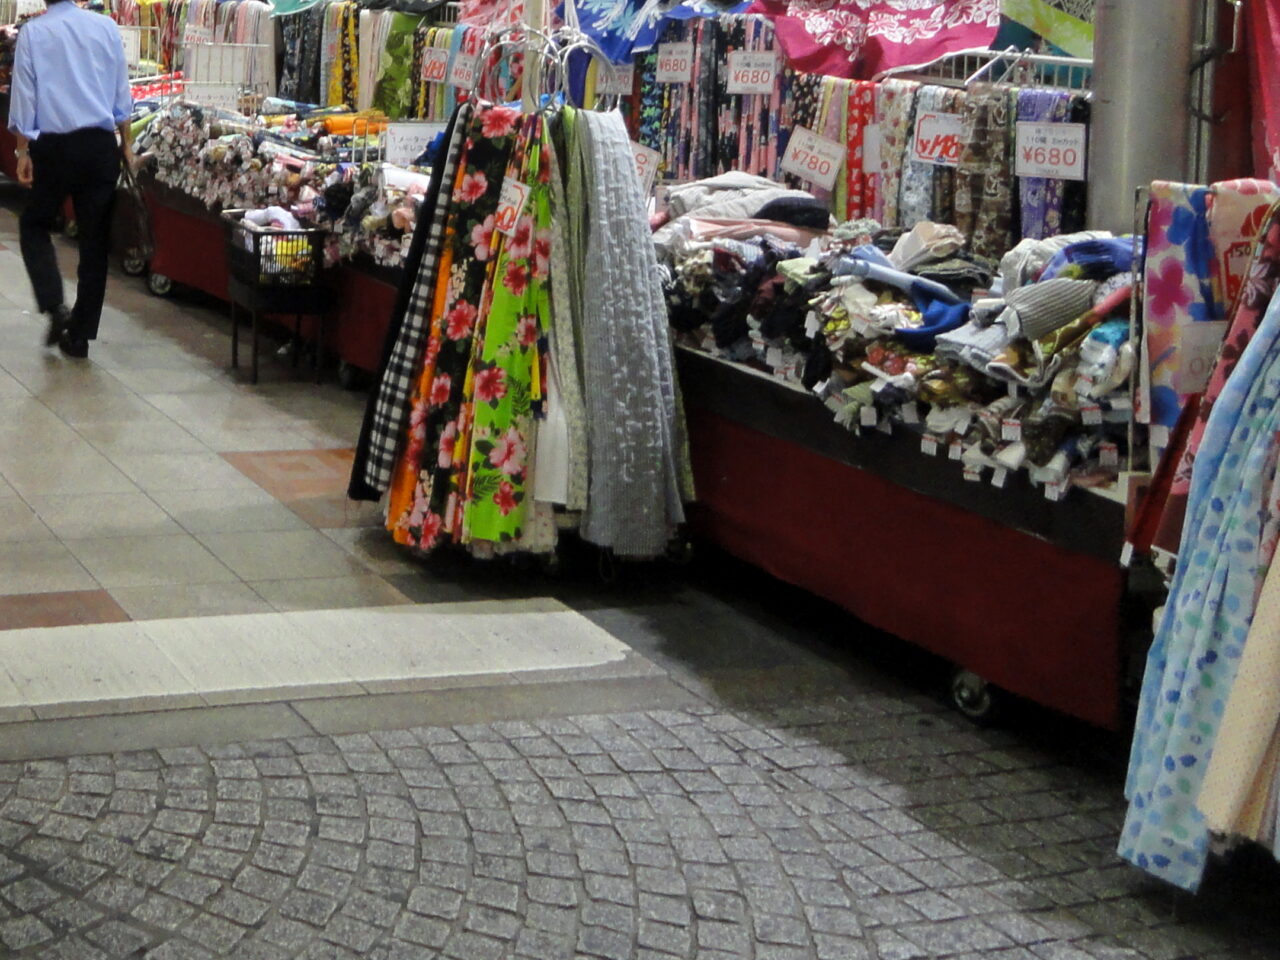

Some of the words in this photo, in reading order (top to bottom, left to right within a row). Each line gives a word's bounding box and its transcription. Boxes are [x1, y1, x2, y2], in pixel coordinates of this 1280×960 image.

[659, 59, 687, 72] ¥680
[733, 69, 771, 84] ¥680
[791, 147, 831, 176] ¥780
[1023, 146, 1077, 166] ¥680
